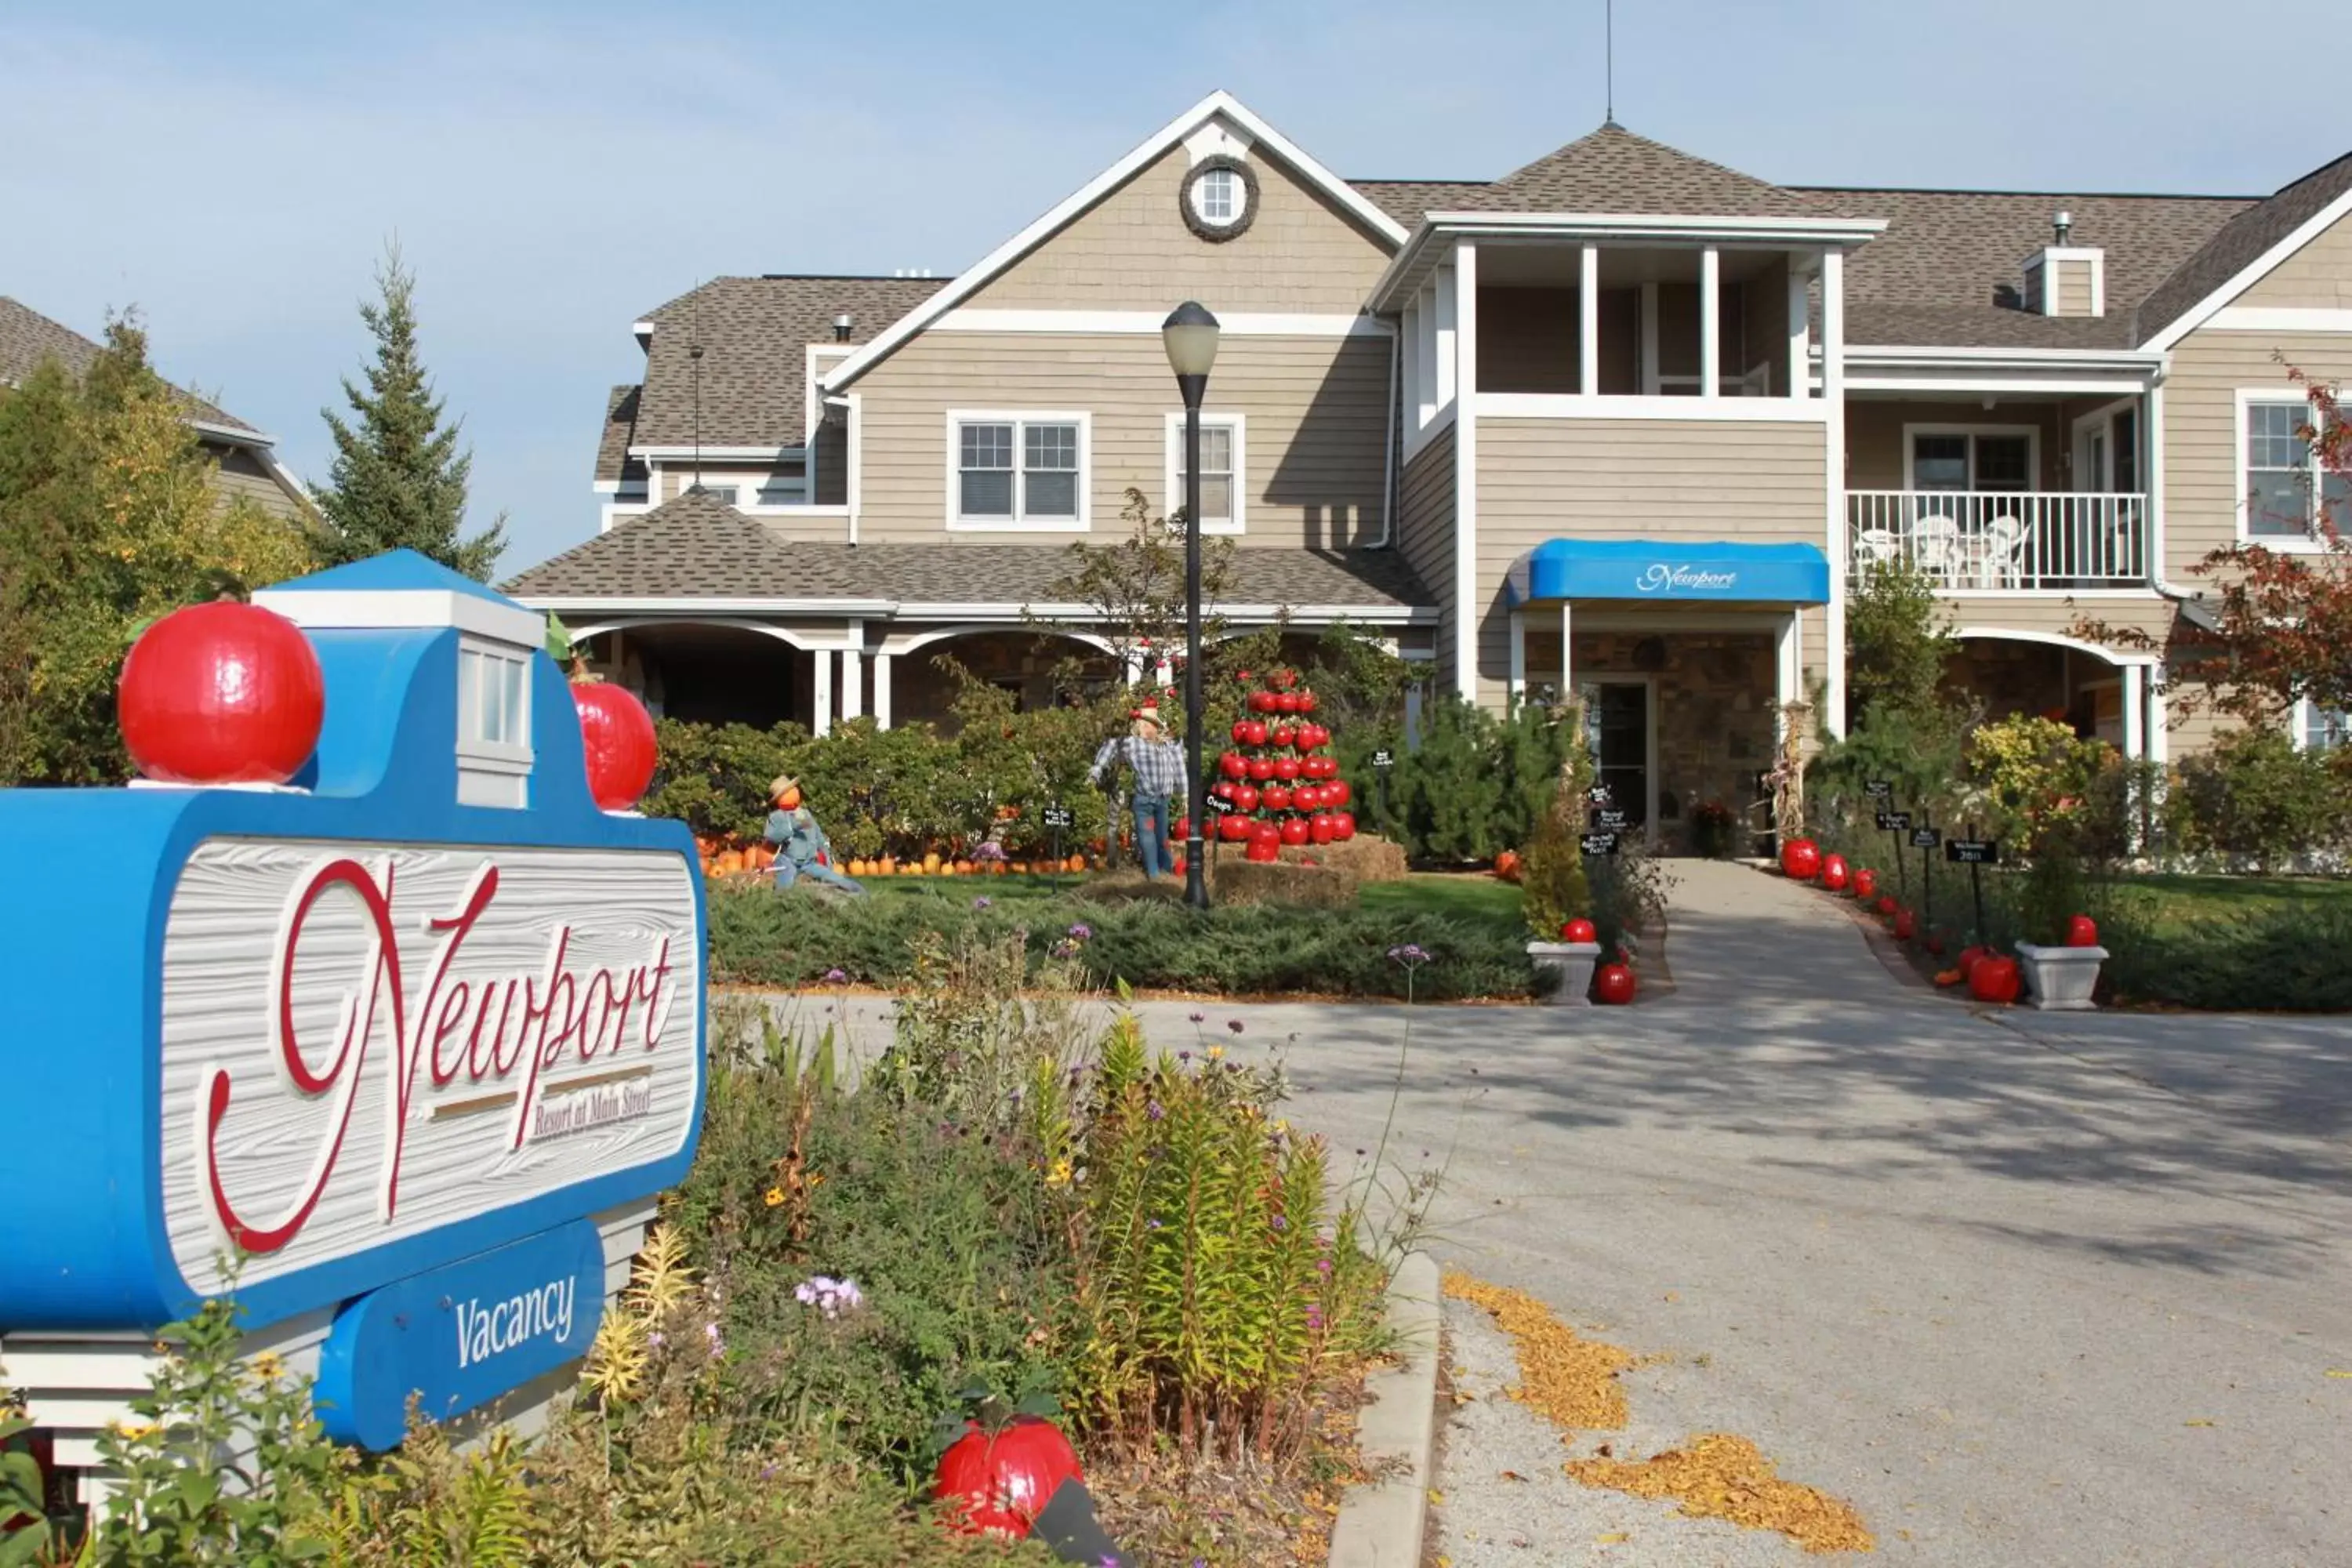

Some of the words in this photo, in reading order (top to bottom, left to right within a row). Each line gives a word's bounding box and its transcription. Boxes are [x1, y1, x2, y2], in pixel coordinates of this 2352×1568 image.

[1635, 564, 1736, 591] Newport
[206, 857, 676, 1254] Newport
[535, 1102, 573, 1135] Resort
[574, 1097, 588, 1127] at
[589, 1091, 619, 1122] Main
[622, 1085, 652, 1116] Street
[455, 1275, 575, 1369] Vacancy
